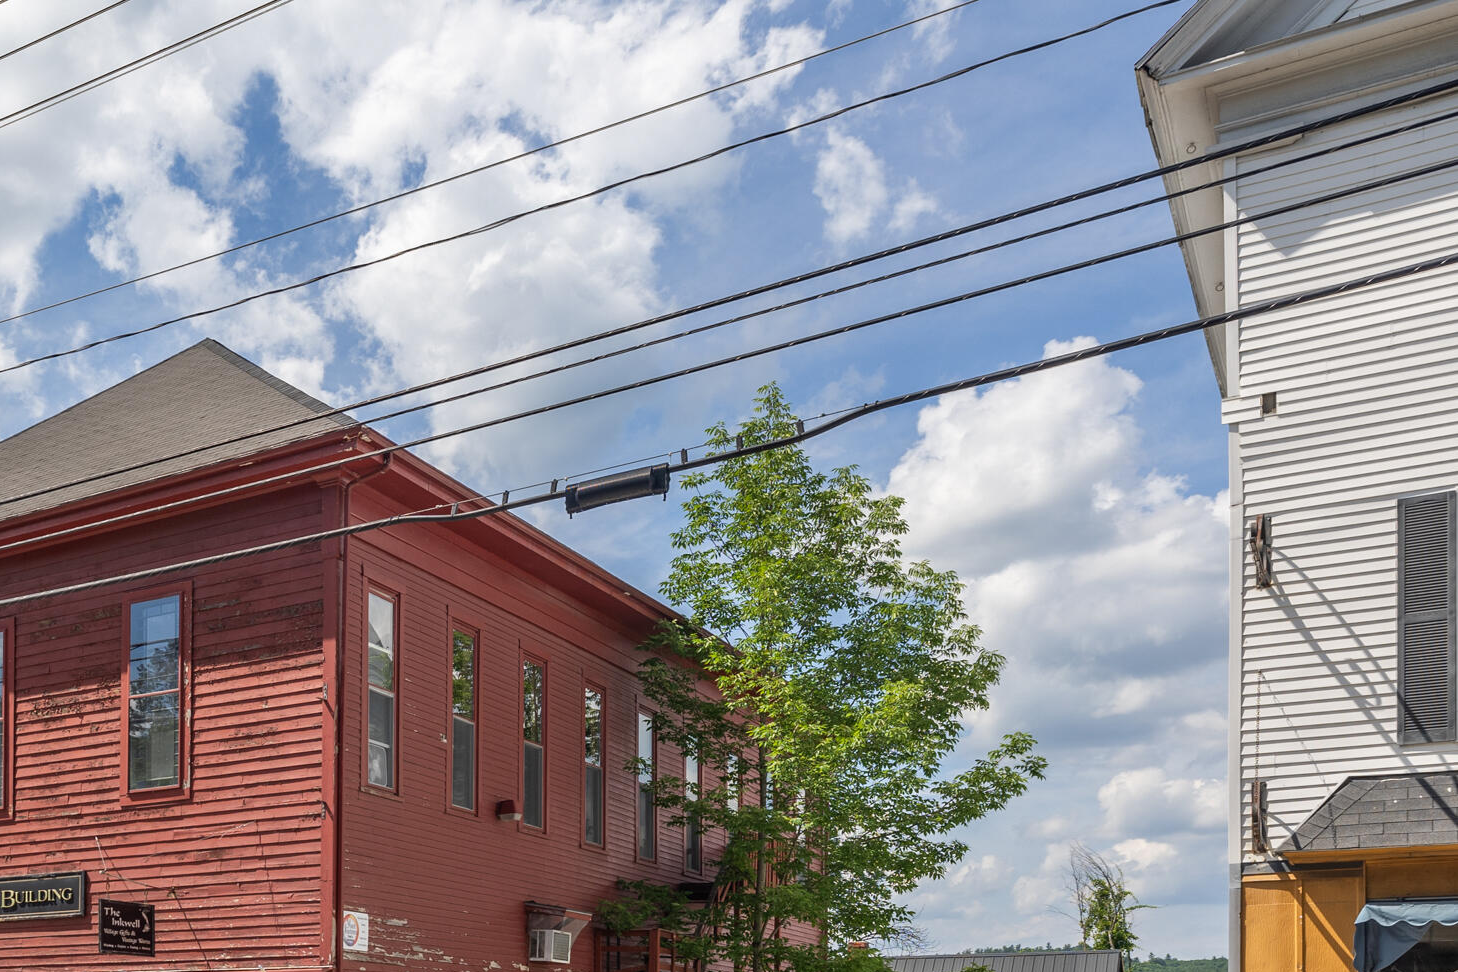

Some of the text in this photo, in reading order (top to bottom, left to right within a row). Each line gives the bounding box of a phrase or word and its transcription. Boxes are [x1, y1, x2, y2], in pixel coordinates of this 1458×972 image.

[1, 888, 73, 909] BUILDING
[103, 906, 121, 917] The
[112, 917, 141, 928] Inkwell
